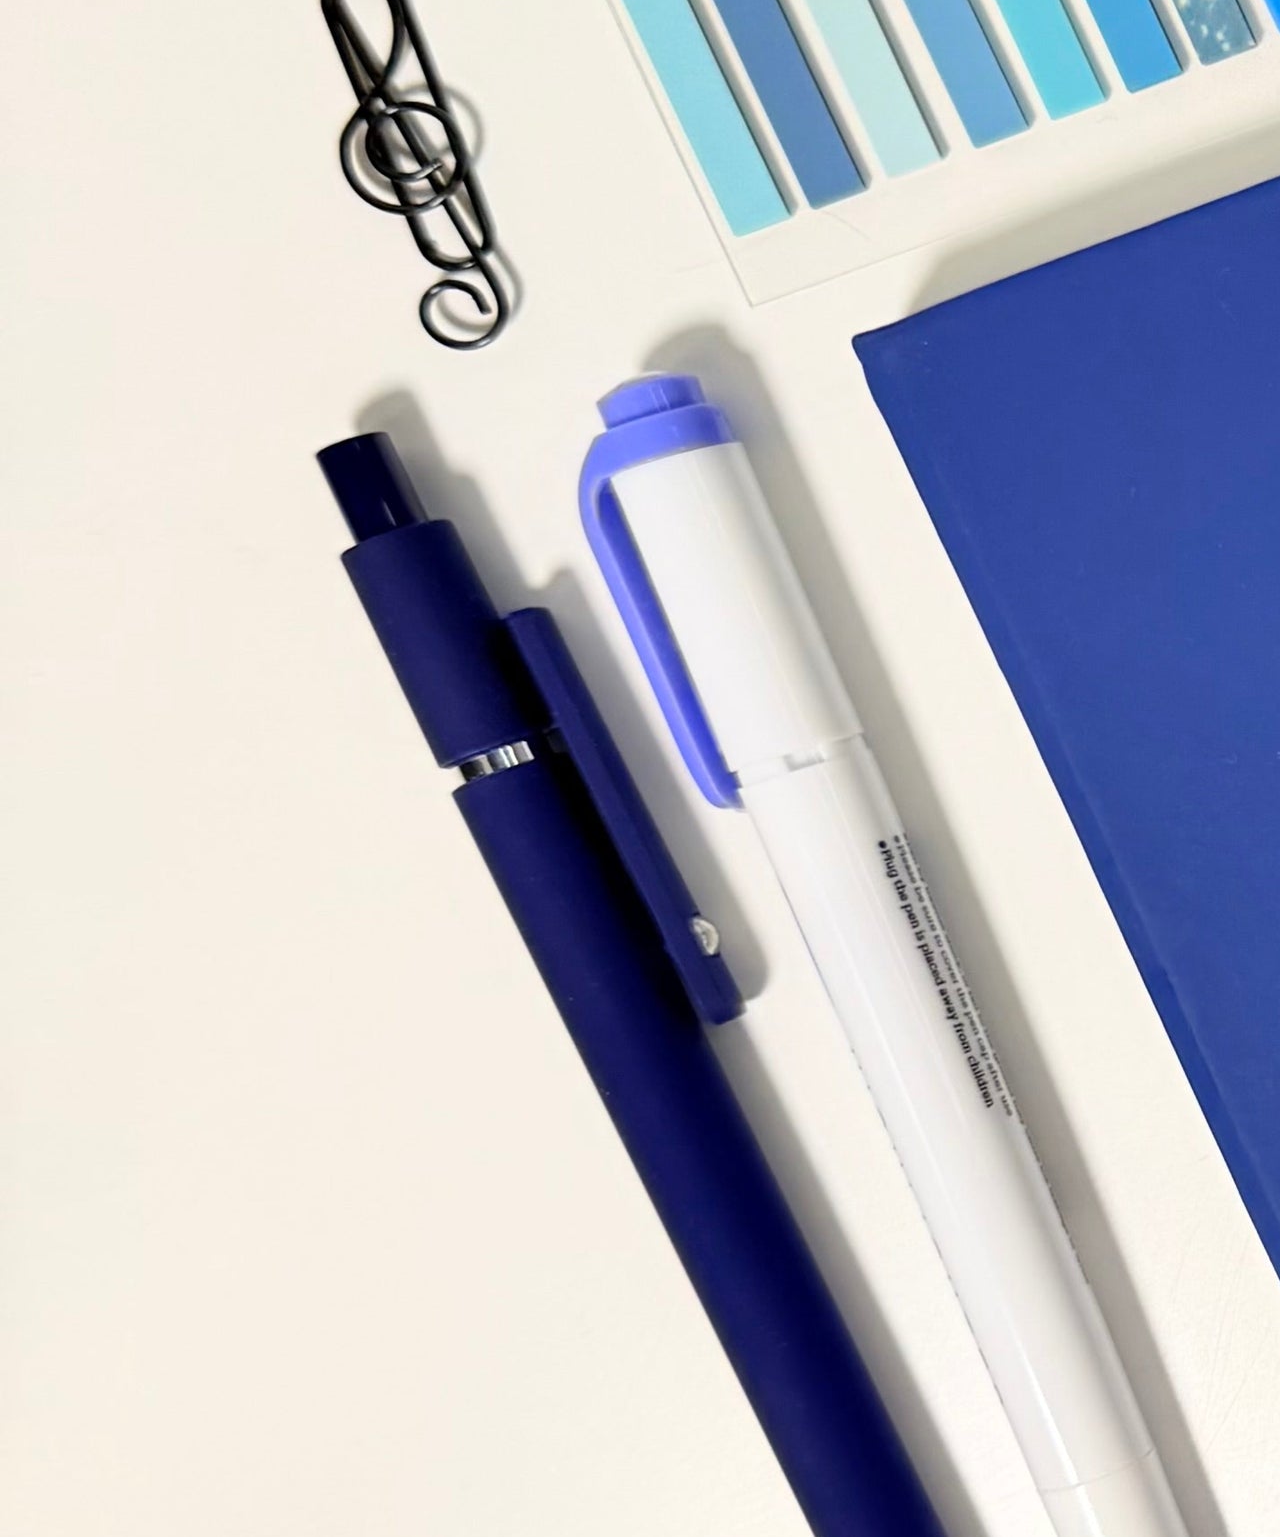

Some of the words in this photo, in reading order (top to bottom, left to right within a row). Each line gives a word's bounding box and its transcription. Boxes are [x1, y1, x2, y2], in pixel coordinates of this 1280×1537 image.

[894, 879, 908, 902] the
[900, 903, 920, 929] pen
[914, 930, 925, 942] is
[917, 943, 946, 986] placed
[939, 988, 959, 1020] away
[953, 1022, 972, 1054] from
[967, 1055, 994, 1108] children
